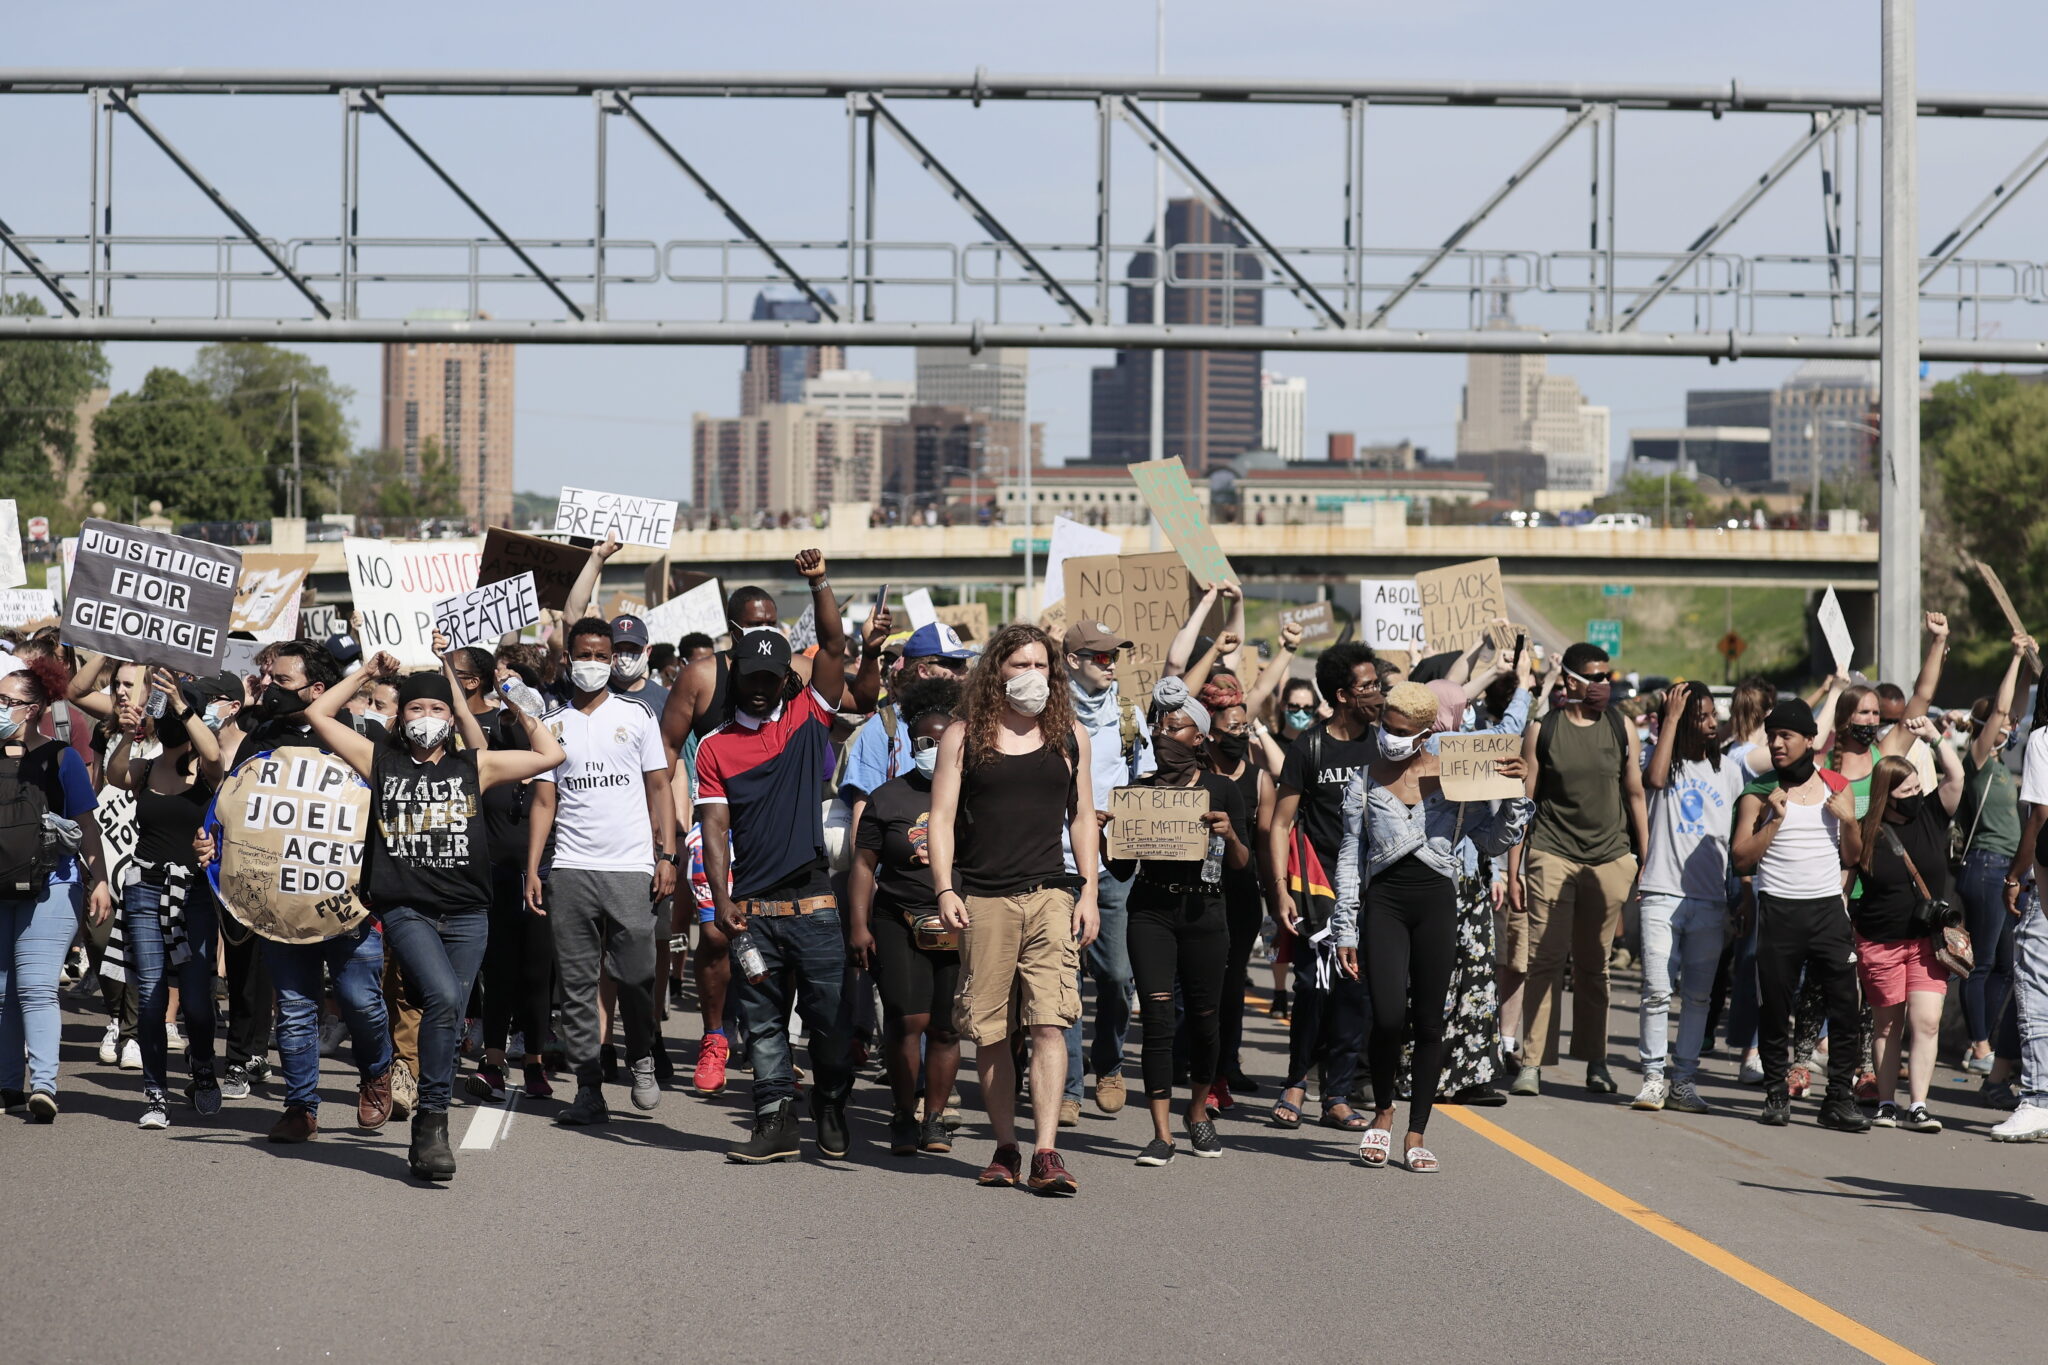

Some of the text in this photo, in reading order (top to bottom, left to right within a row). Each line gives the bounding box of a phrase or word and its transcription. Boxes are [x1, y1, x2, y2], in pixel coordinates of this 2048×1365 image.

[560, 490, 667, 517] I CAN'T
[557, 505, 671, 545] BREATHE
[85, 532, 232, 584] JUSTICE
[504, 541, 559, 565] END
[357, 555, 393, 589] NO
[1080, 567, 1125, 598] NO
[116, 572, 186, 609] FOR
[436, 574, 528, 619] I CAN'T
[1375, 585, 1419, 604] ABOL
[1421, 573, 1496, 607] BLACK
[75, 602, 217, 655] GEORGE
[363, 610, 402, 646] NO
[436, 586, 539, 654] BREATHE
[1430, 598, 1497, 635] LIVES
[1440, 738, 1515, 753] MY BLACK
[260, 760, 344, 792] RIP
[564, 774, 630, 791] Emirates
[585, 761, 604, 773] Fly
[1441, 759, 1470, 777] LIFE
[382, 775, 467, 801] BLACK
[1113, 790, 1204, 811] MY BLACK
[247, 796, 352, 832] JOEL
[382, 802, 469, 833] LIVES
[1112, 818, 1146, 839] LIFE
[1675, 821, 1705, 836] APE
[284, 837, 365, 866] ACEV
[280, 867, 345, 892] EDO
